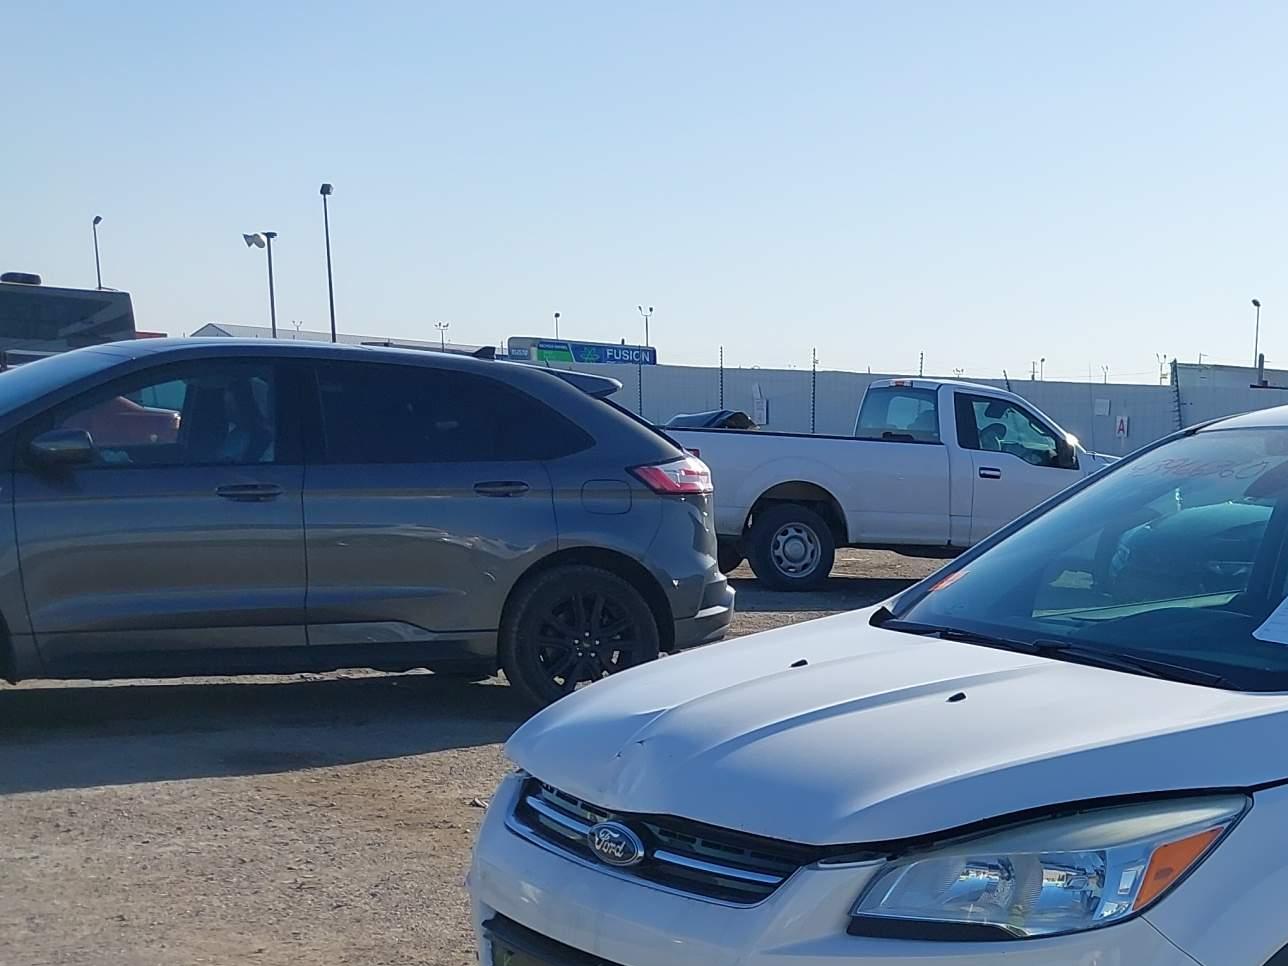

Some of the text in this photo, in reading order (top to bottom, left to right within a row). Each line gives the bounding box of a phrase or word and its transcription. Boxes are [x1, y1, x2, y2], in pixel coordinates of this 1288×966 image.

[606, 349, 651, 362] FUSION
[1117, 418, 1126, 434] A
[594, 828, 627, 858] Ford
